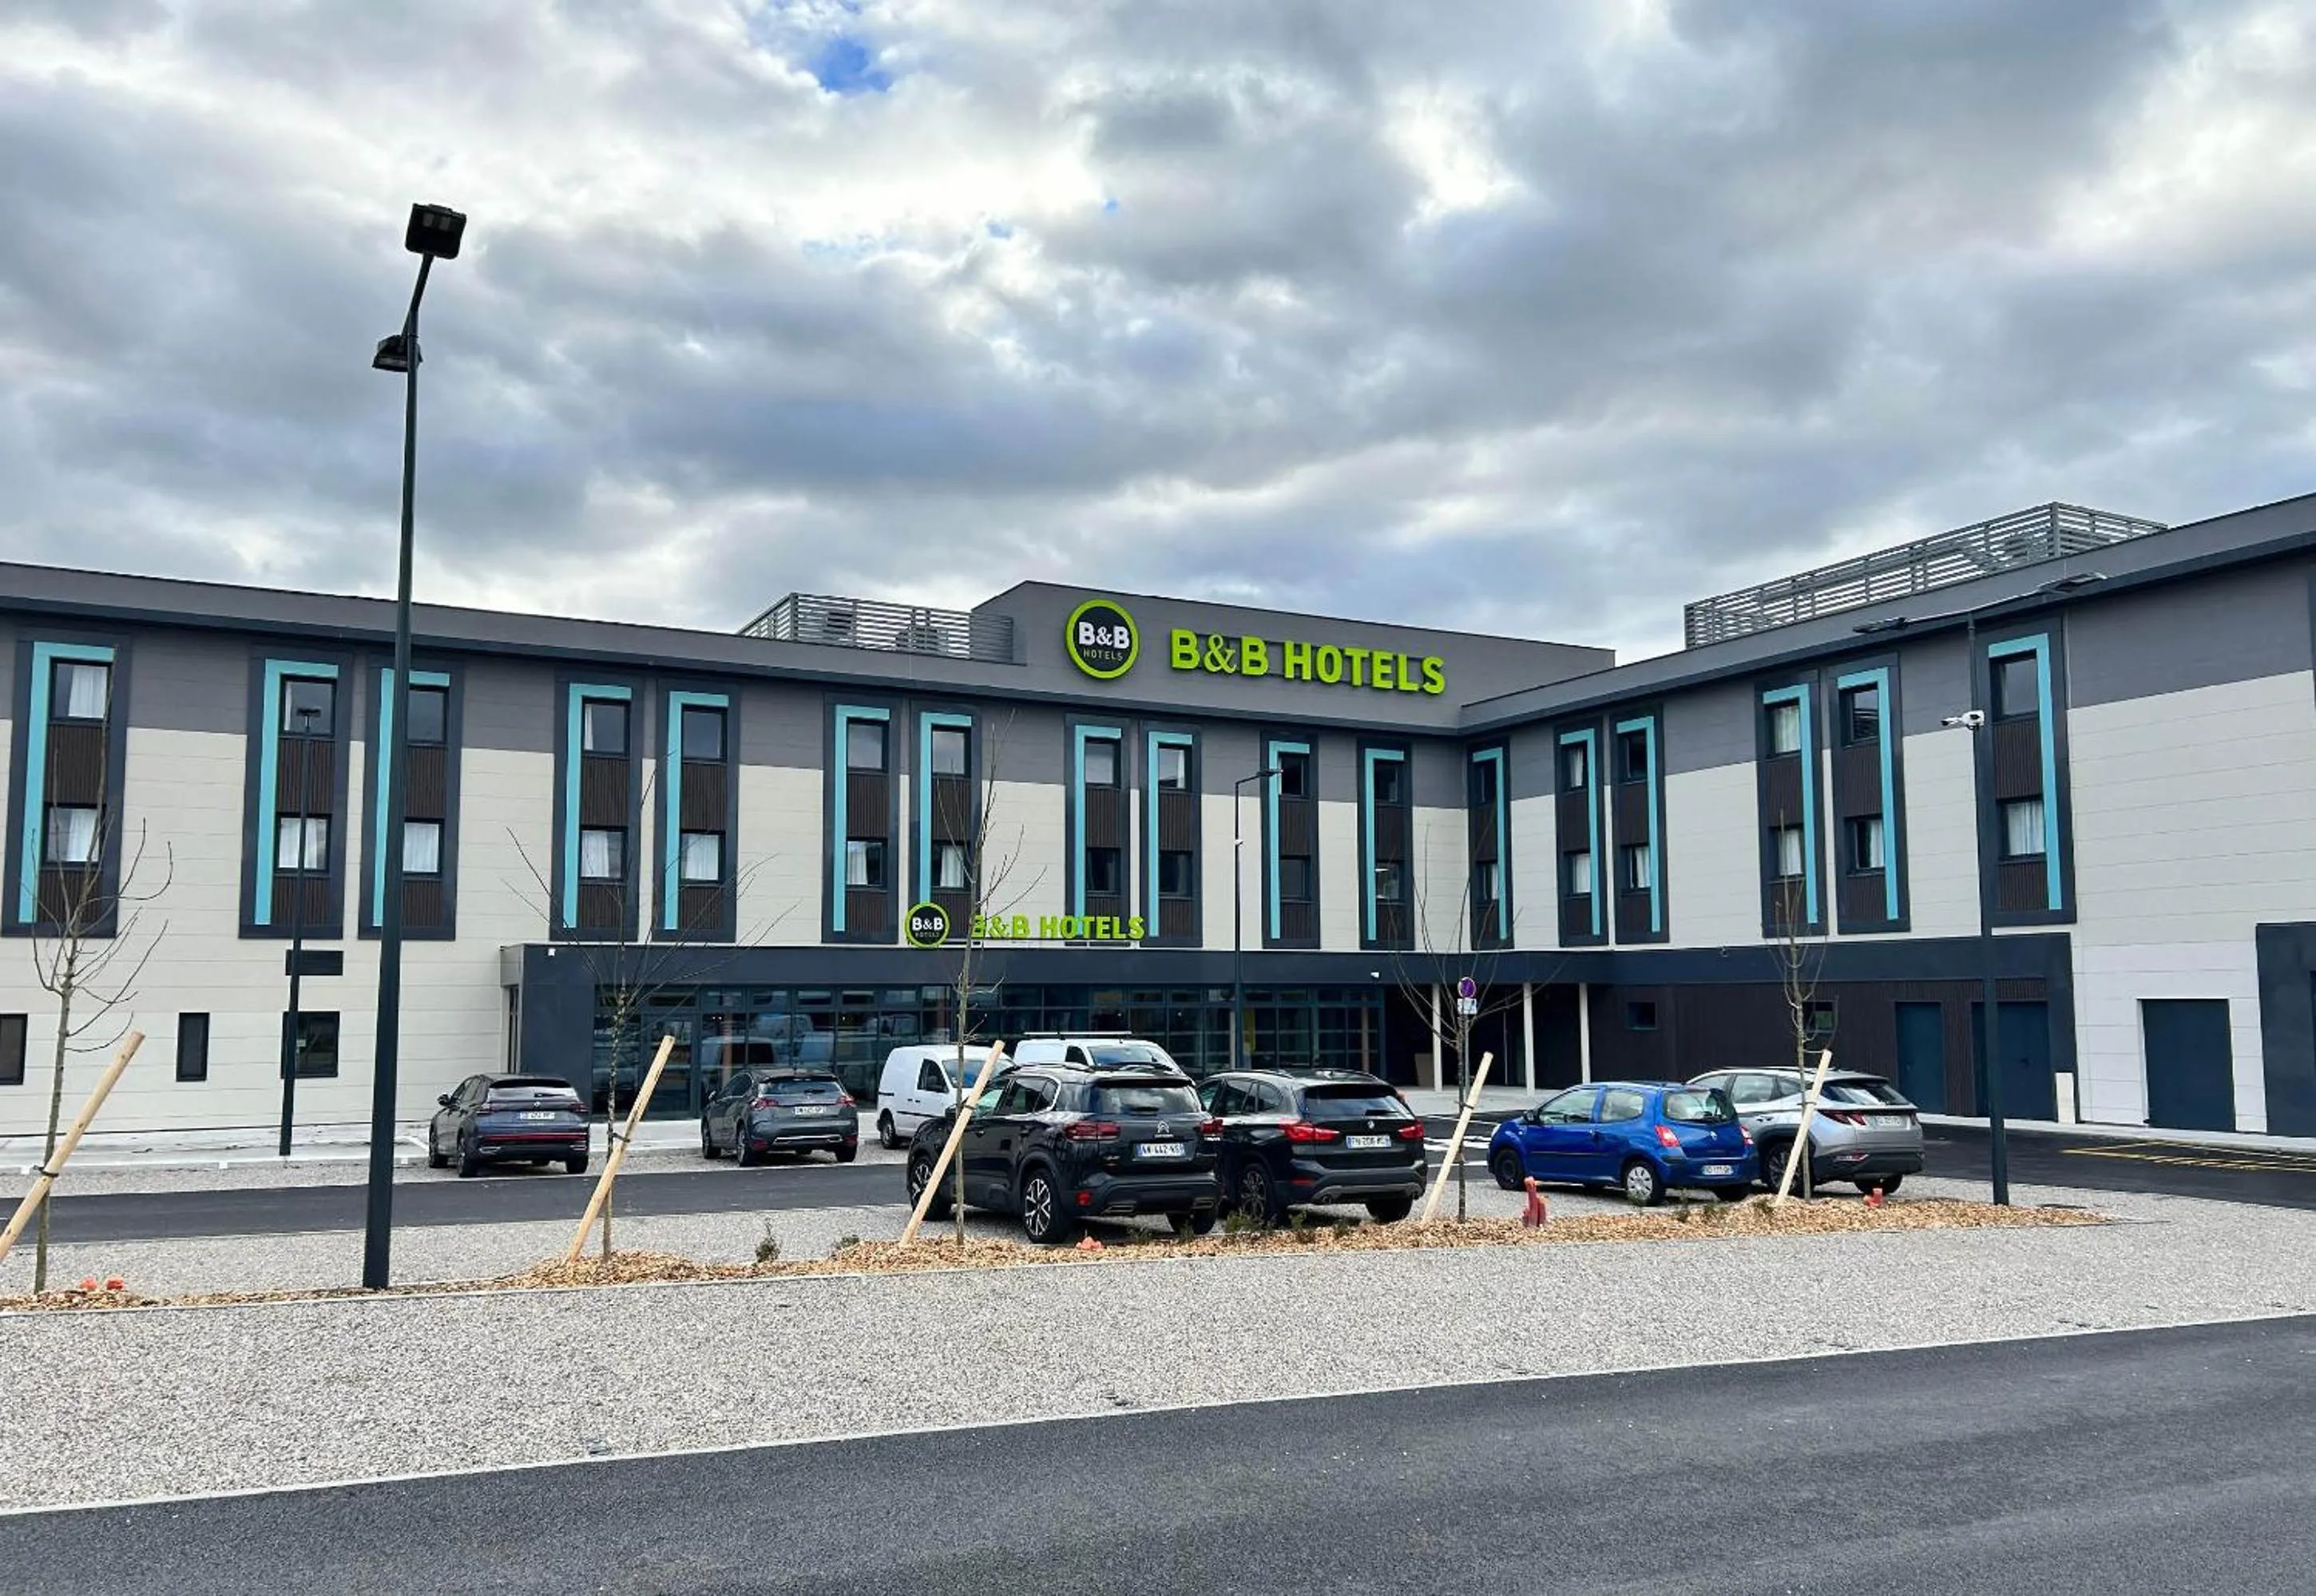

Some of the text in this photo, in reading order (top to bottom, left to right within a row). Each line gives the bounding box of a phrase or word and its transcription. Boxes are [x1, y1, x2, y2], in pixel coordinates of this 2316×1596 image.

[1078, 621, 1130, 649] B&B
[1083, 648, 1124, 662] HOTELS
[1171, 628, 1446, 695] B&B HOTELS
[912, 917, 944, 931] B&B
[1040, 916, 1145, 940] HOTELS
